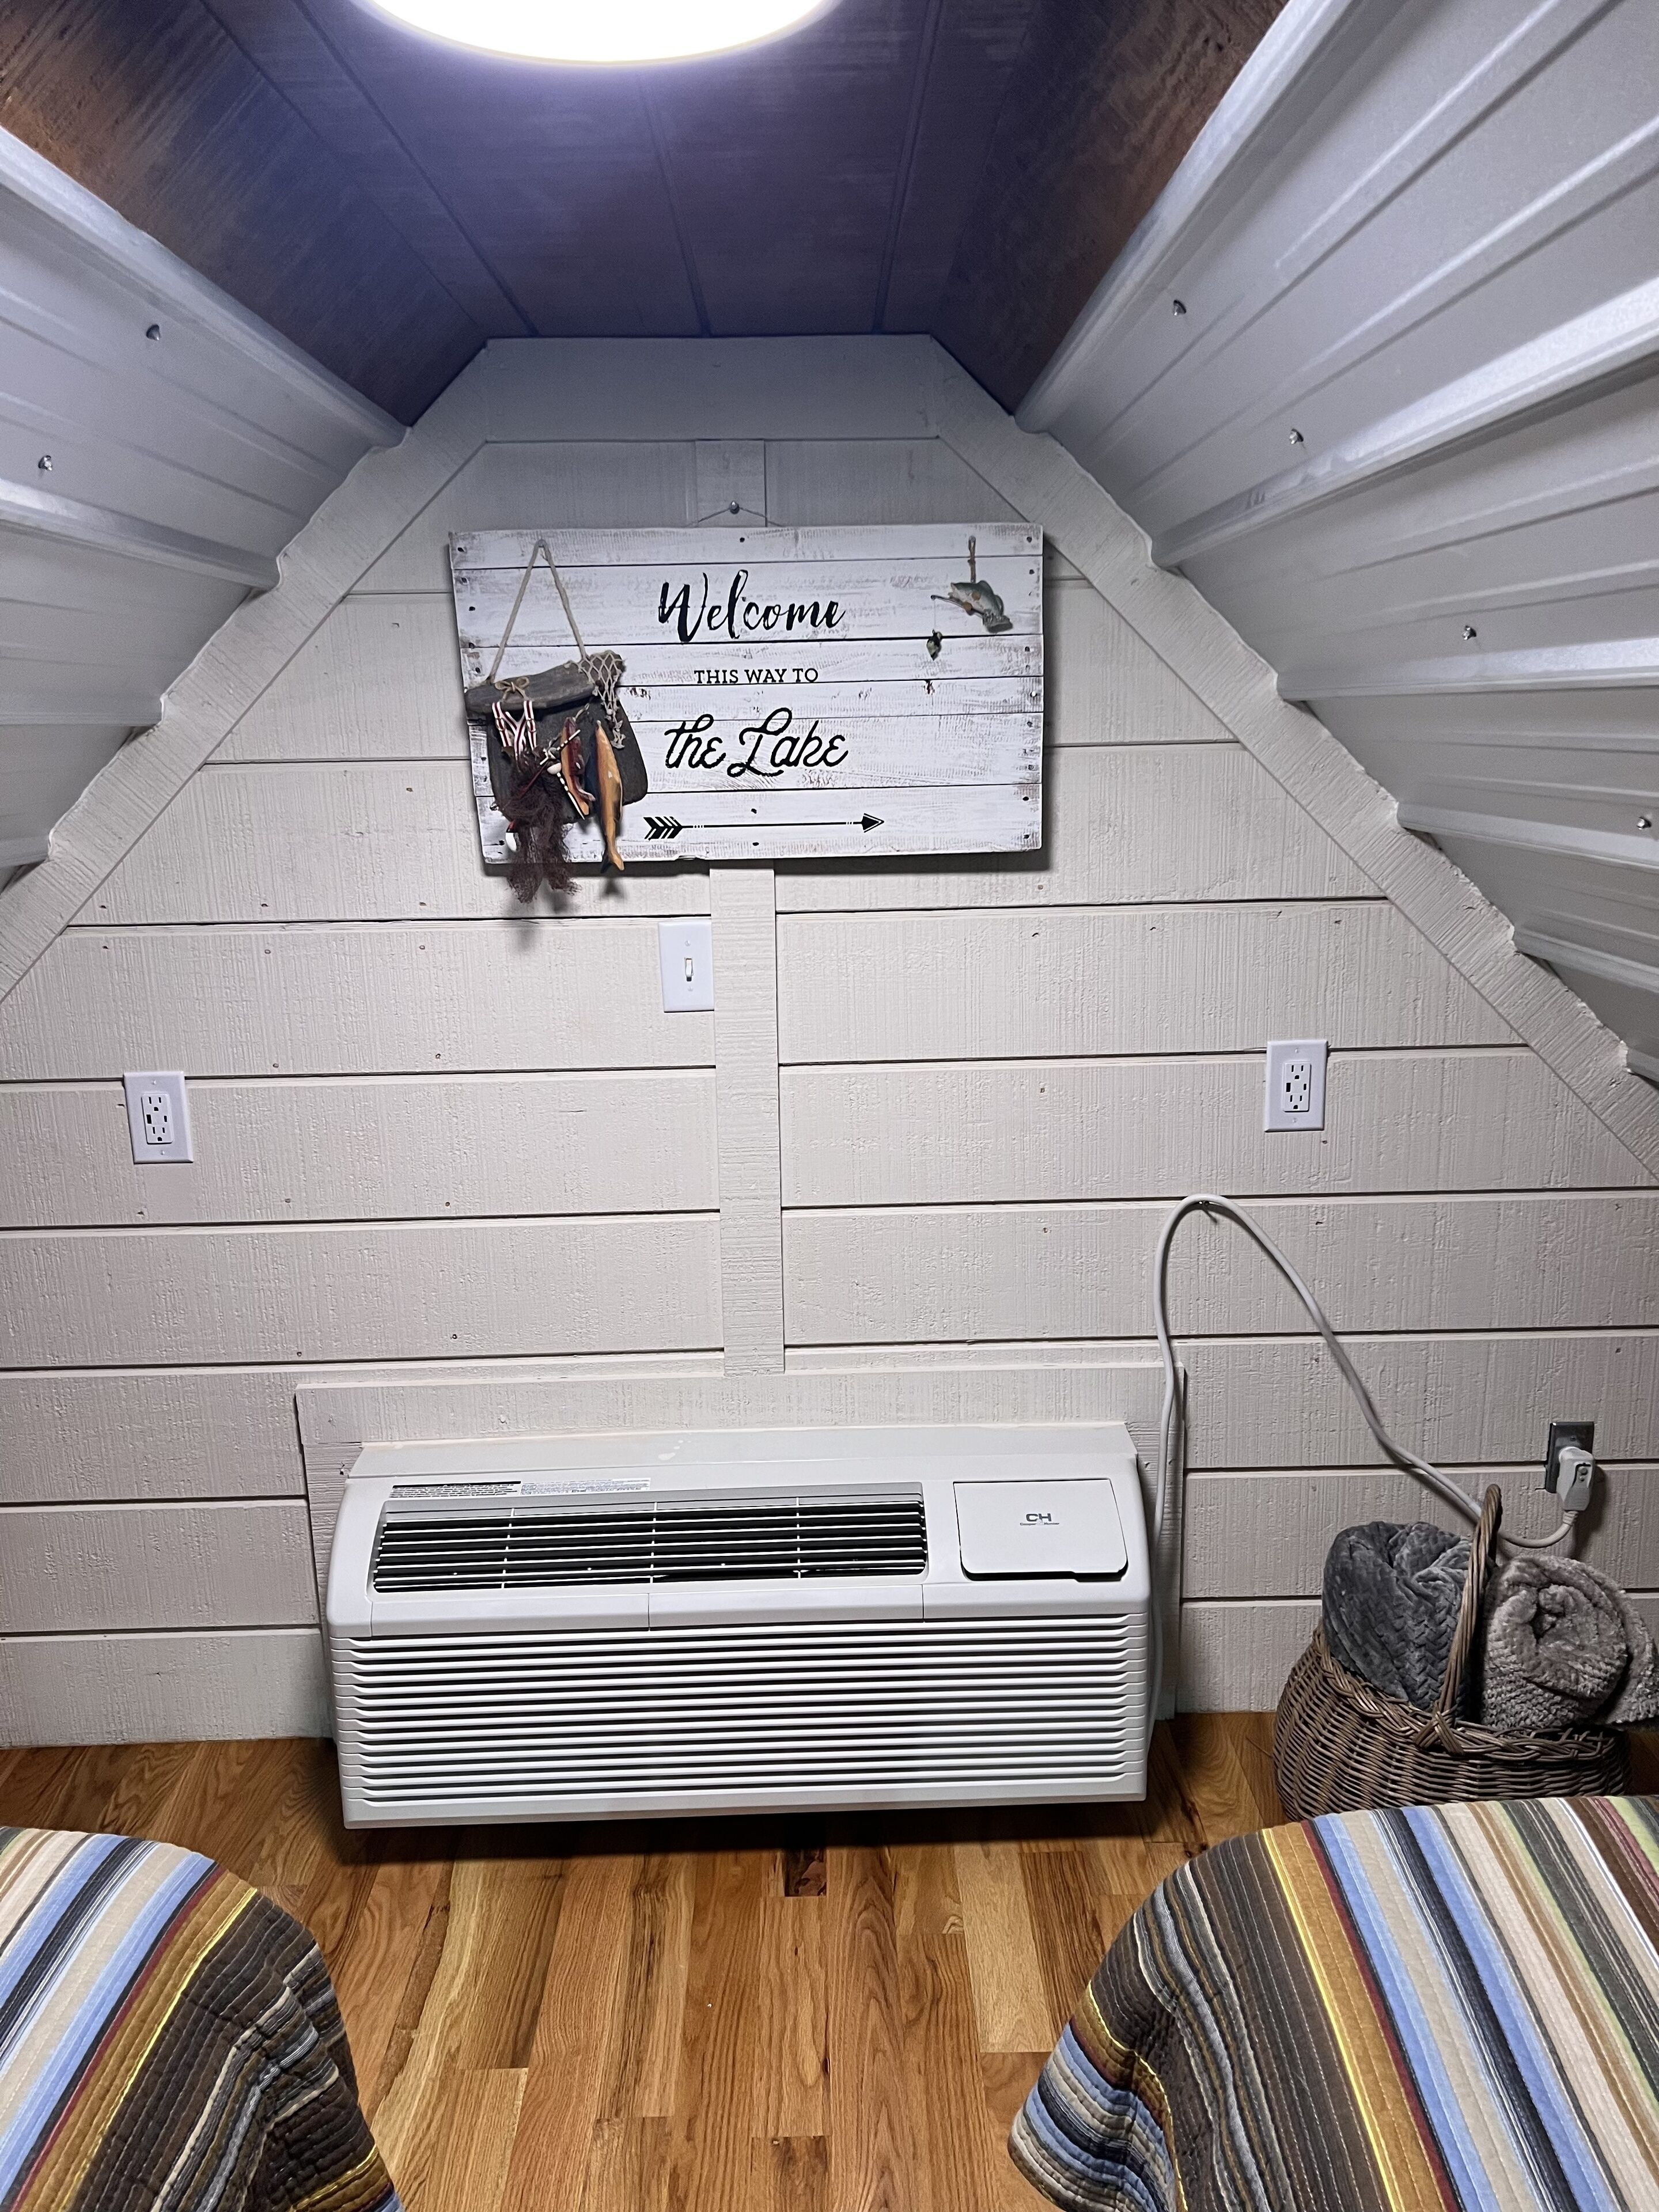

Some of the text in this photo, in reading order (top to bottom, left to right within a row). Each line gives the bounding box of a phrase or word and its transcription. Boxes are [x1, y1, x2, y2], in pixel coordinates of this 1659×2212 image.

[658, 569, 846, 642] Welcome
[694, 668, 819, 684] THIS WAY TO
[664, 707, 849, 778] the Lake
[1026, 1513, 1052, 1522] CH
